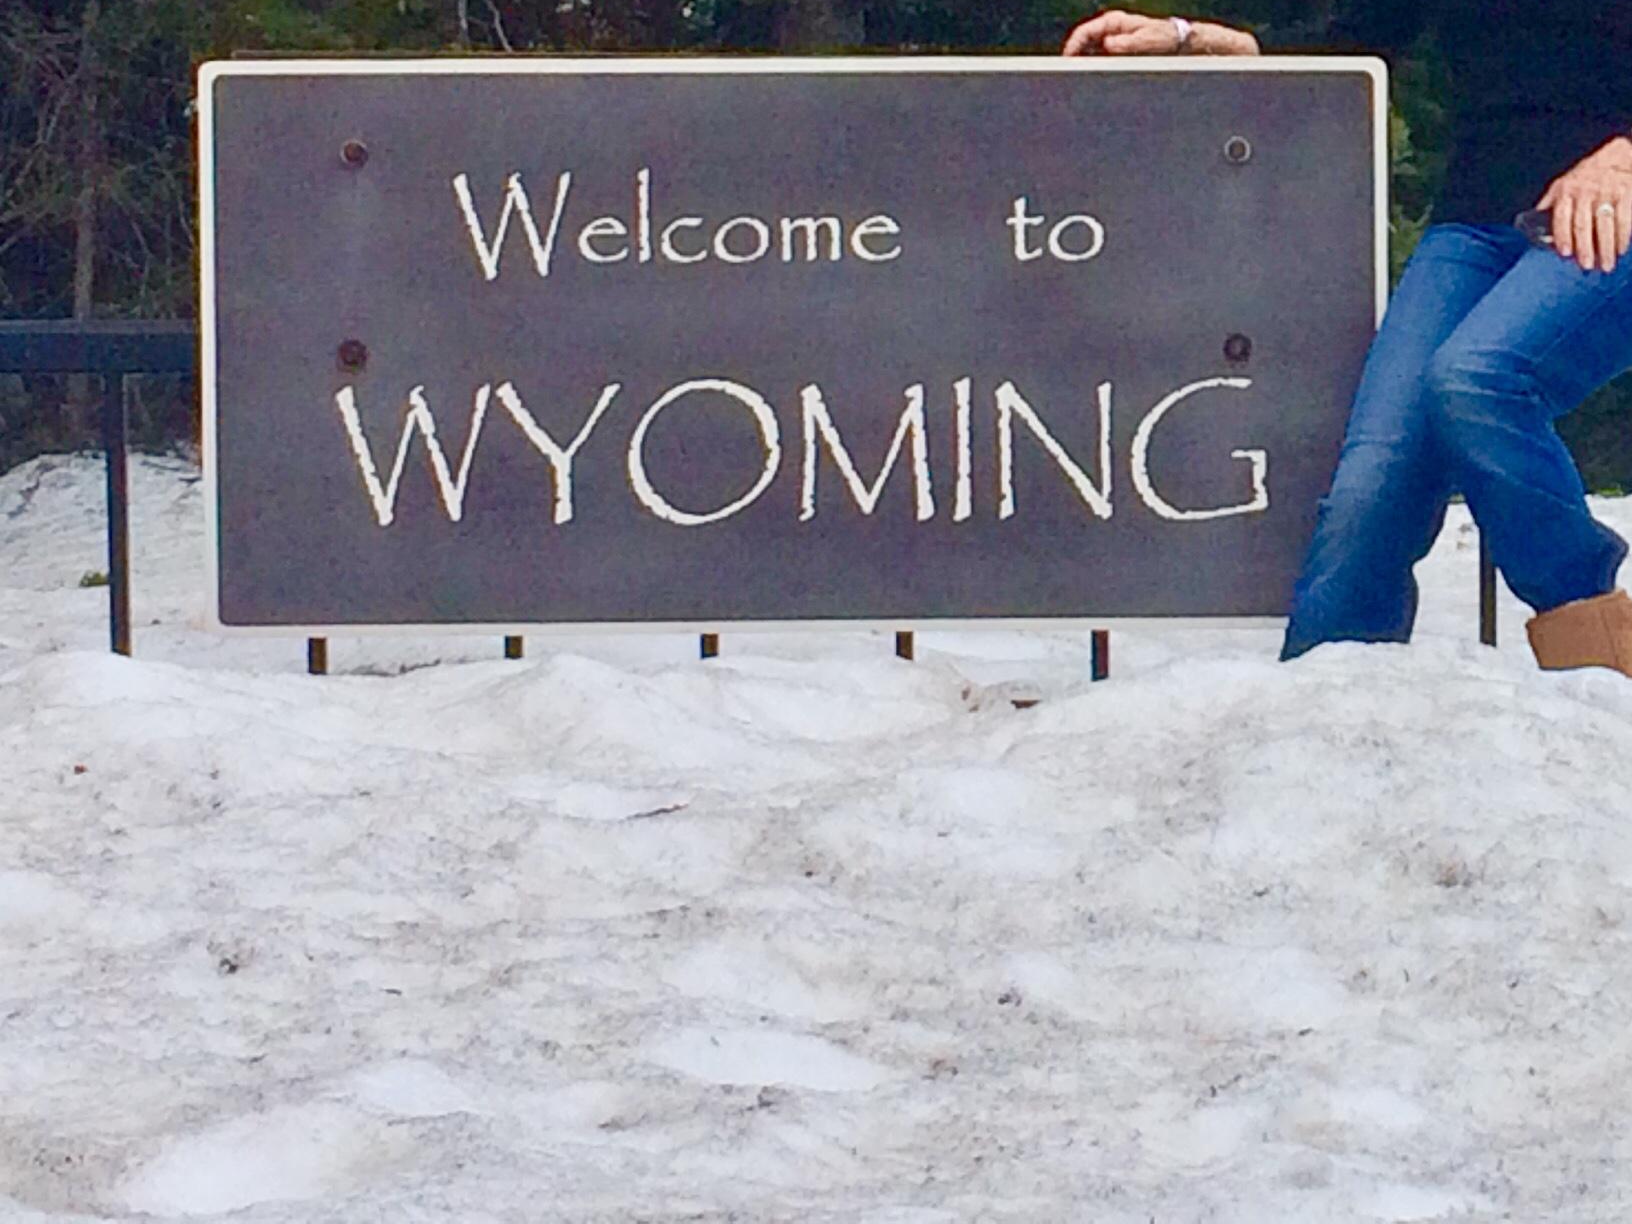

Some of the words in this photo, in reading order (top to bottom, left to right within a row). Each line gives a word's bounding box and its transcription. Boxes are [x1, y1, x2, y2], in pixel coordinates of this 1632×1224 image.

[452, 167, 902, 281] Welcome
[1005, 196, 1105, 262] to
[334, 376, 1269, 528] WYOMING
